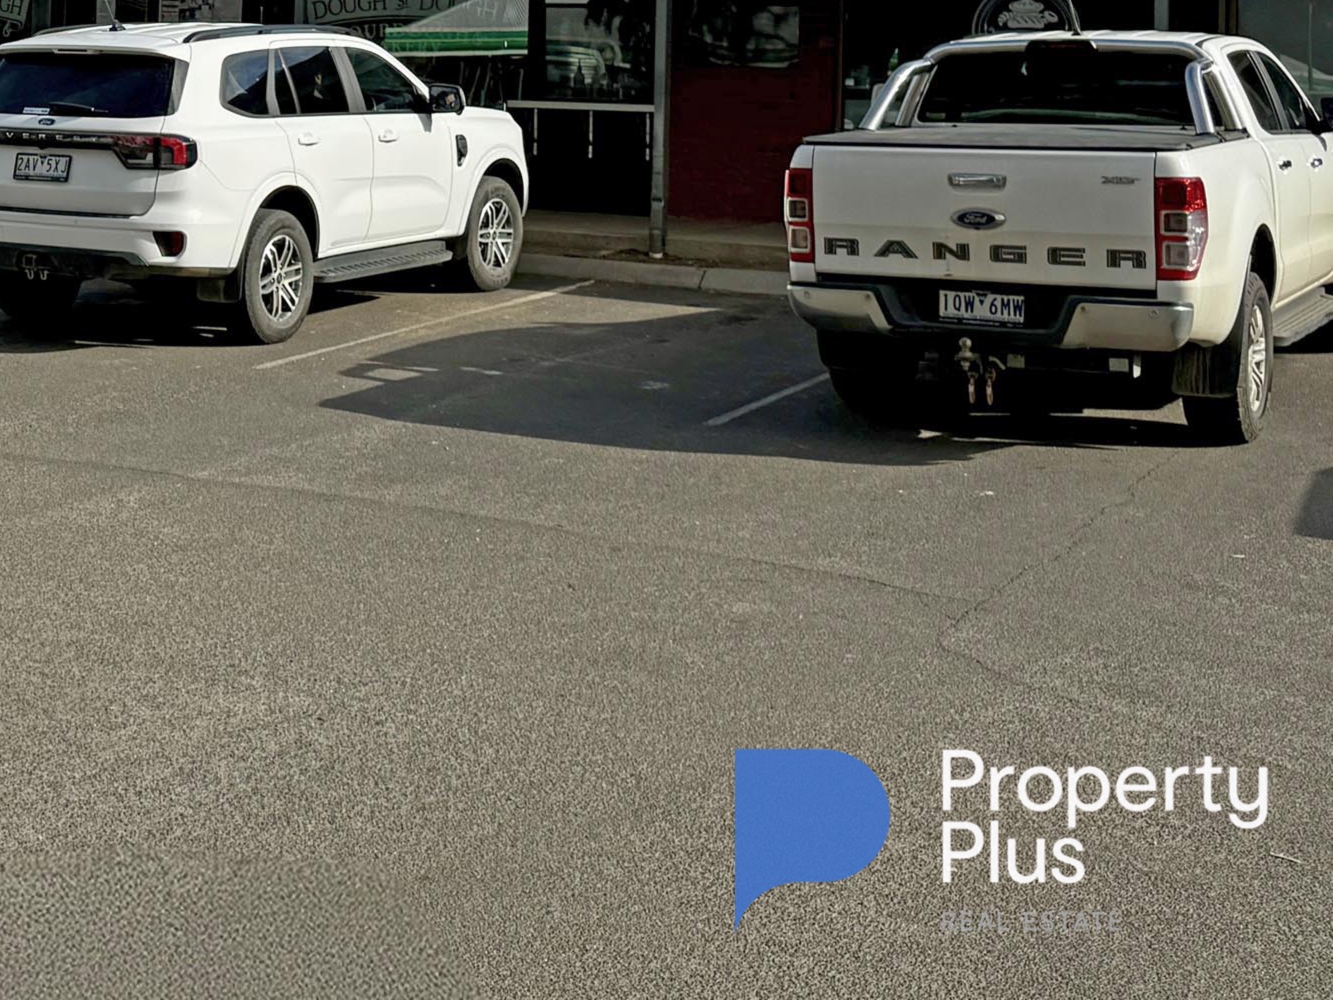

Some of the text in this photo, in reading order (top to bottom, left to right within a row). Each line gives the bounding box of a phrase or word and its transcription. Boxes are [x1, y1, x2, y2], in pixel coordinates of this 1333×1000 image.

[17, 156, 68, 174] 2AV 5XJ
[964, 213, 987, 224] Ford
[823, 236, 1147, 269] RANGER
[989, 297, 1024, 318] 6MW
